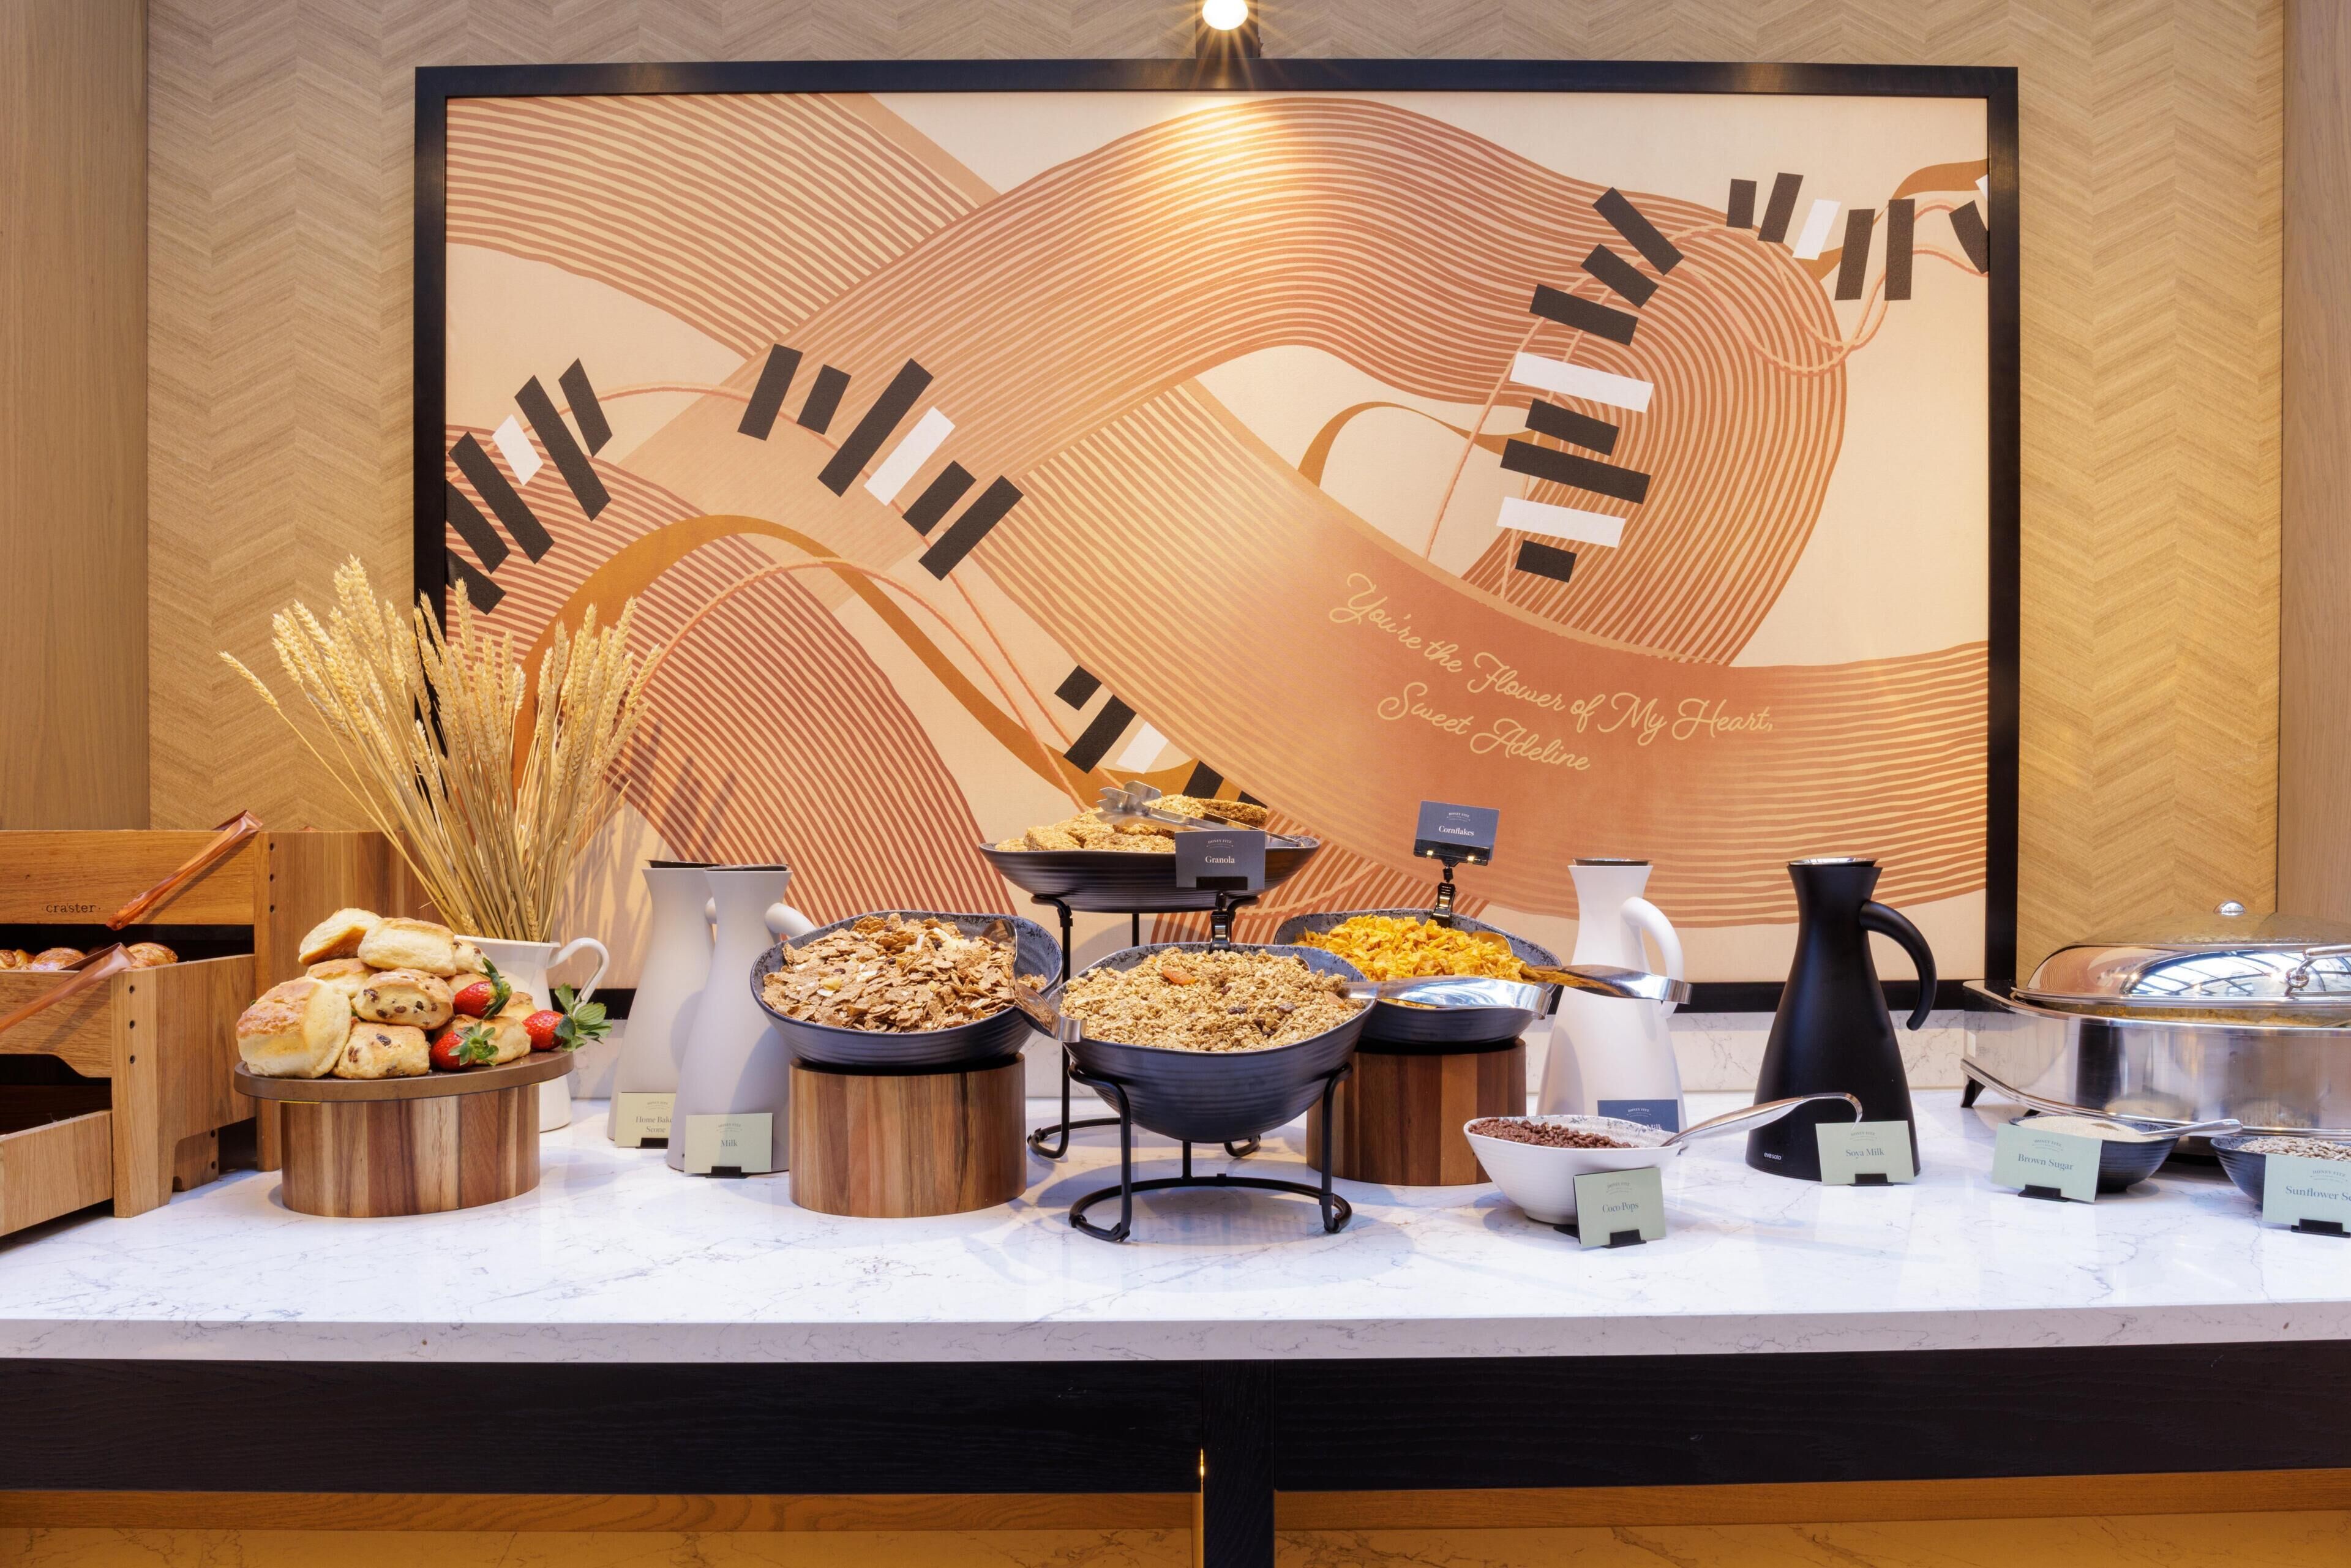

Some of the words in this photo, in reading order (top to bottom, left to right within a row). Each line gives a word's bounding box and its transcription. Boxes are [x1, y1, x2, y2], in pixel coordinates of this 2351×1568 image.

[1329, 572, 1422, 648] You're
[1423, 640, 1463, 672] the
[1467, 651, 1565, 711] Flower
[1570, 694, 1606, 733] of
[1597, 692, 1667, 746] My
[1671, 698, 1773, 740] Heart,
[1377, 681, 1474, 734] Sweet
[1469, 718, 1591, 770] Adeline
[1439, 825, 1474, 836] Cornflakes
[1205, 855, 1235, 864] Granola
[1846, 1149, 1864, 1159] Soya
[1865, 1147, 1884, 1156] Milk
[2018, 1153, 2047, 1166] Brown
[2048, 1158, 2075, 1171] Sugar
[2285, 1185, 2339, 1200] Sunflower
[1602, 1204, 1621, 1213] Coco
[1621, 1202, 1640, 1213] Pops
